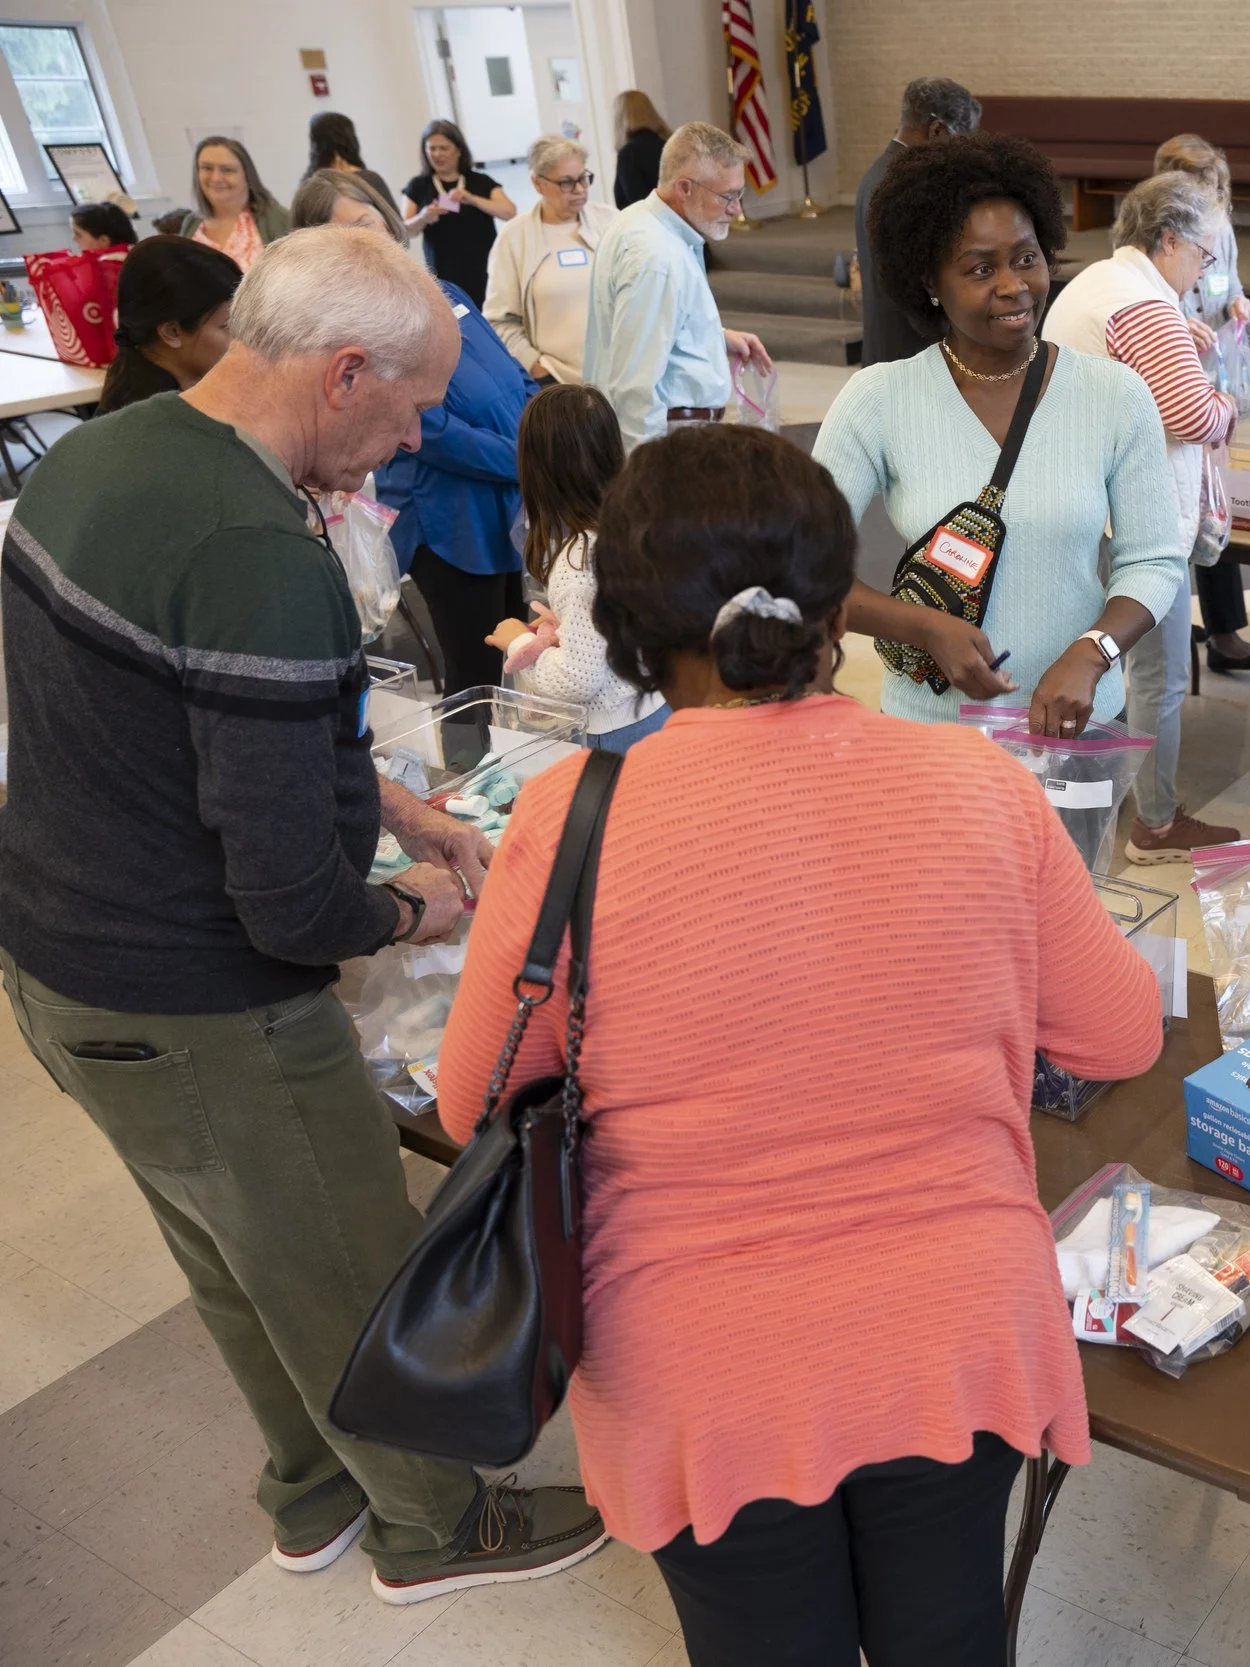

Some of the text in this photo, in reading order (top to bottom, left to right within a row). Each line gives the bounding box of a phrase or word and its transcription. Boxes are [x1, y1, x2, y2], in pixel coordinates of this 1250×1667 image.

[1203, 1112, 1222, 1126] gallon
[1190, 1116, 1235, 1147] storage
[1218, 1159, 1229, 1171] 120
